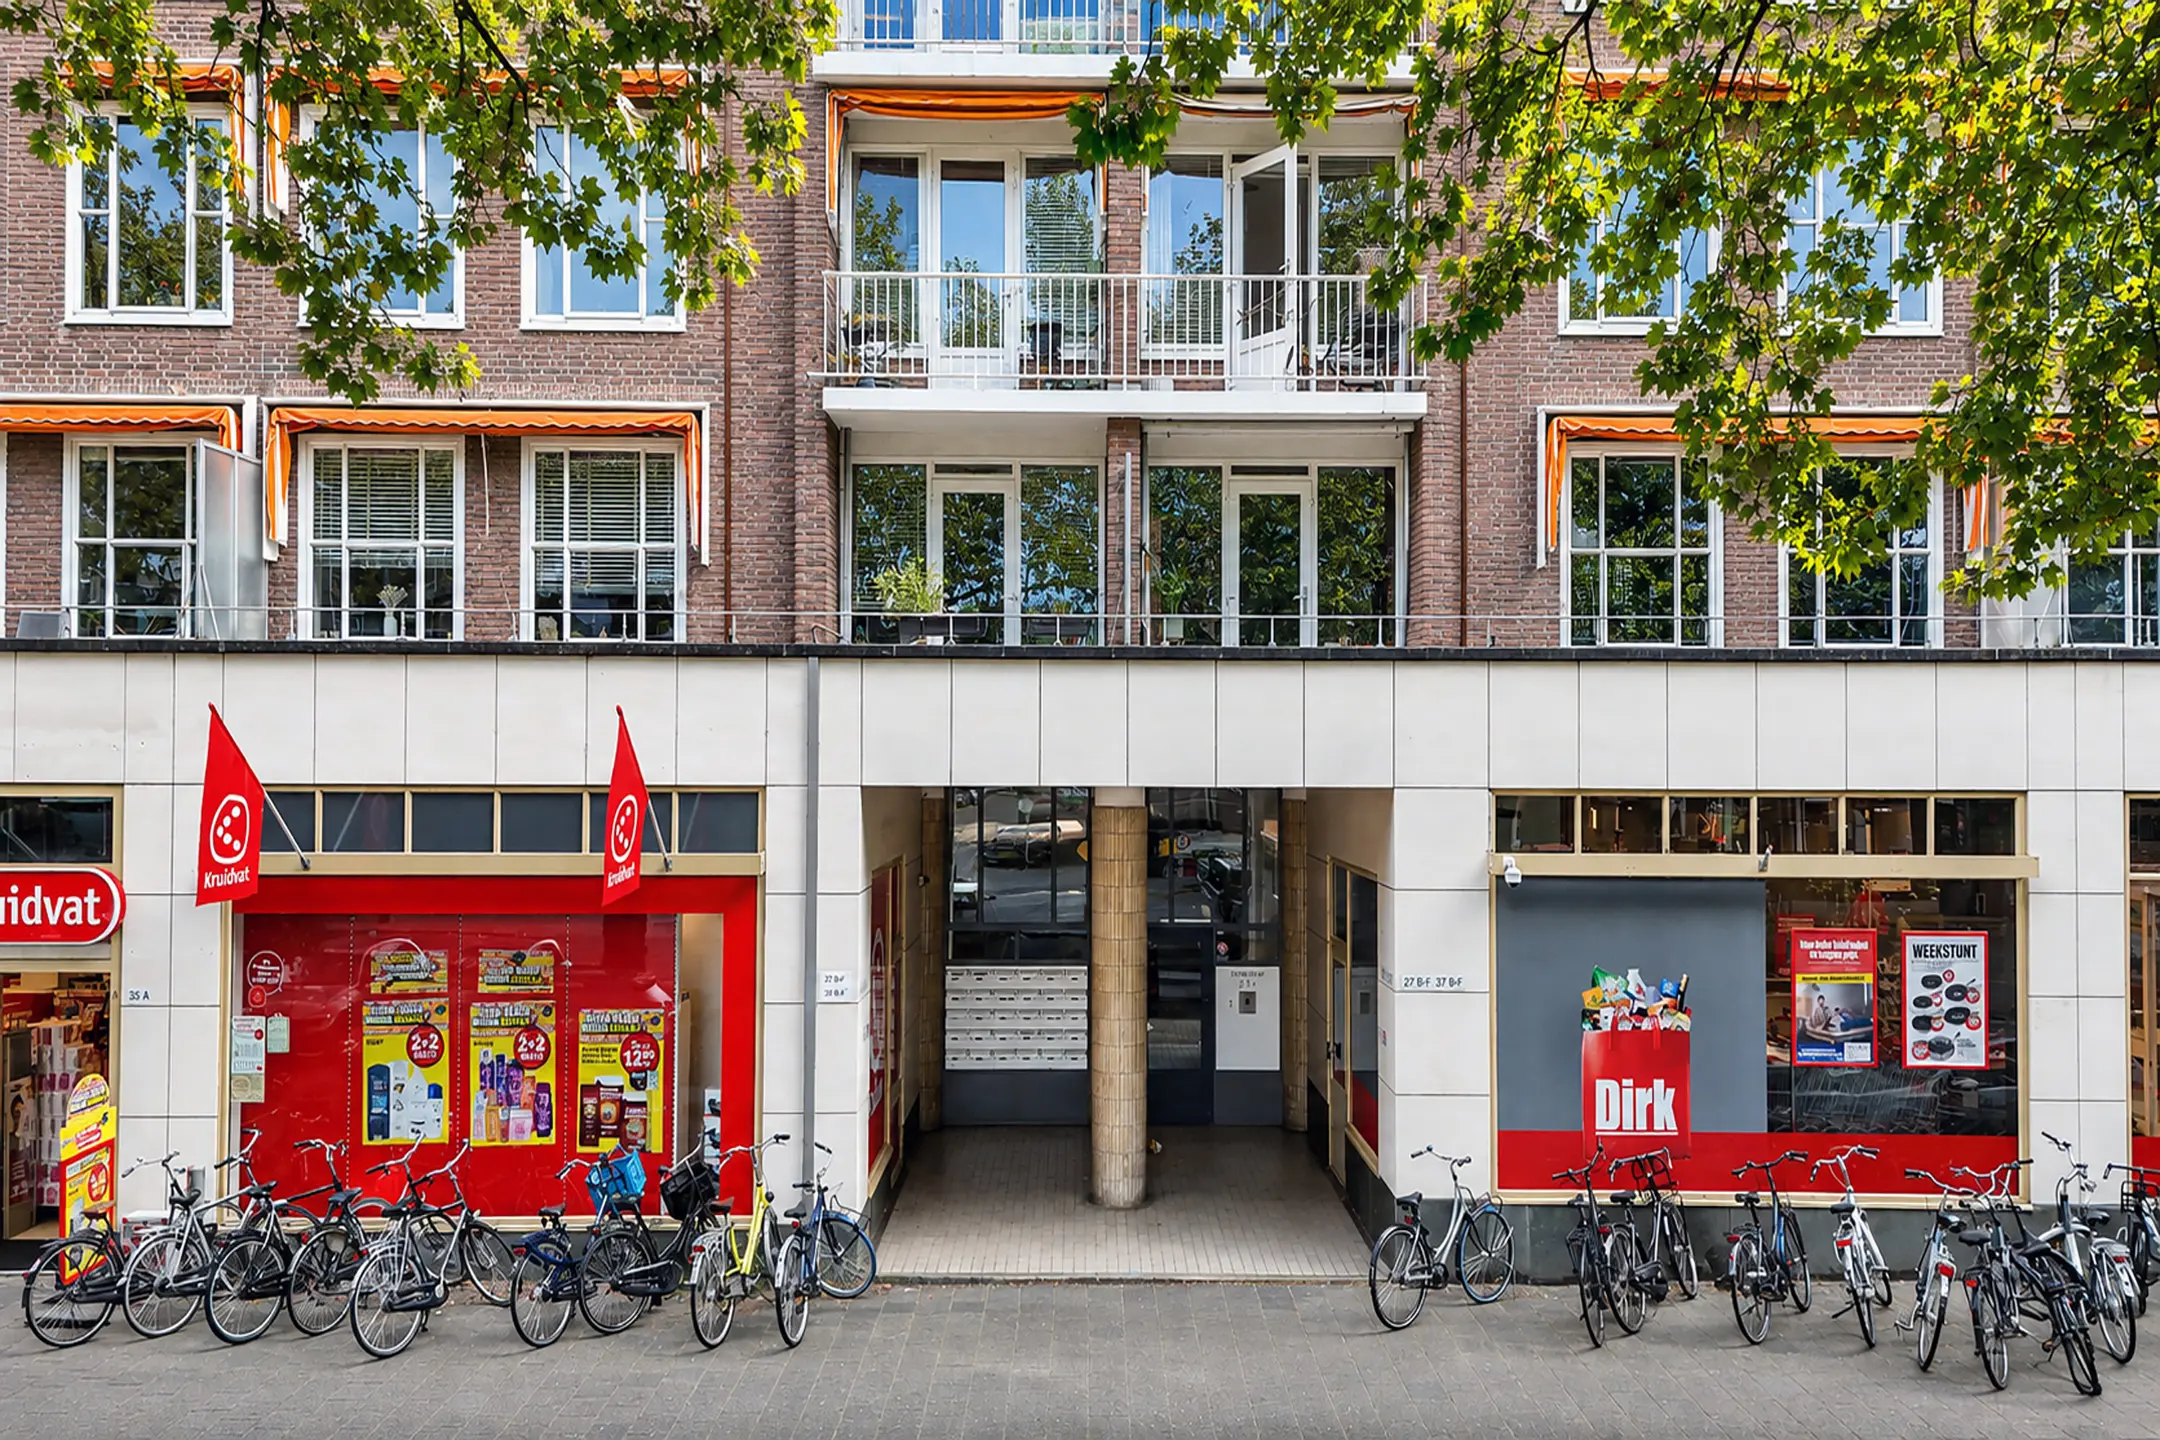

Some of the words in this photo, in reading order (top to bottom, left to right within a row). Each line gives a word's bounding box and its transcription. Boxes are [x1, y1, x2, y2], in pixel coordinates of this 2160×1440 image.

[204, 866, 251, 889] Kruidvat
[1912, 944, 1977, 959] WEEKSTUNT
[143, 990, 151, 1001] A
[1595, 1079, 1678, 1131] Dirk
